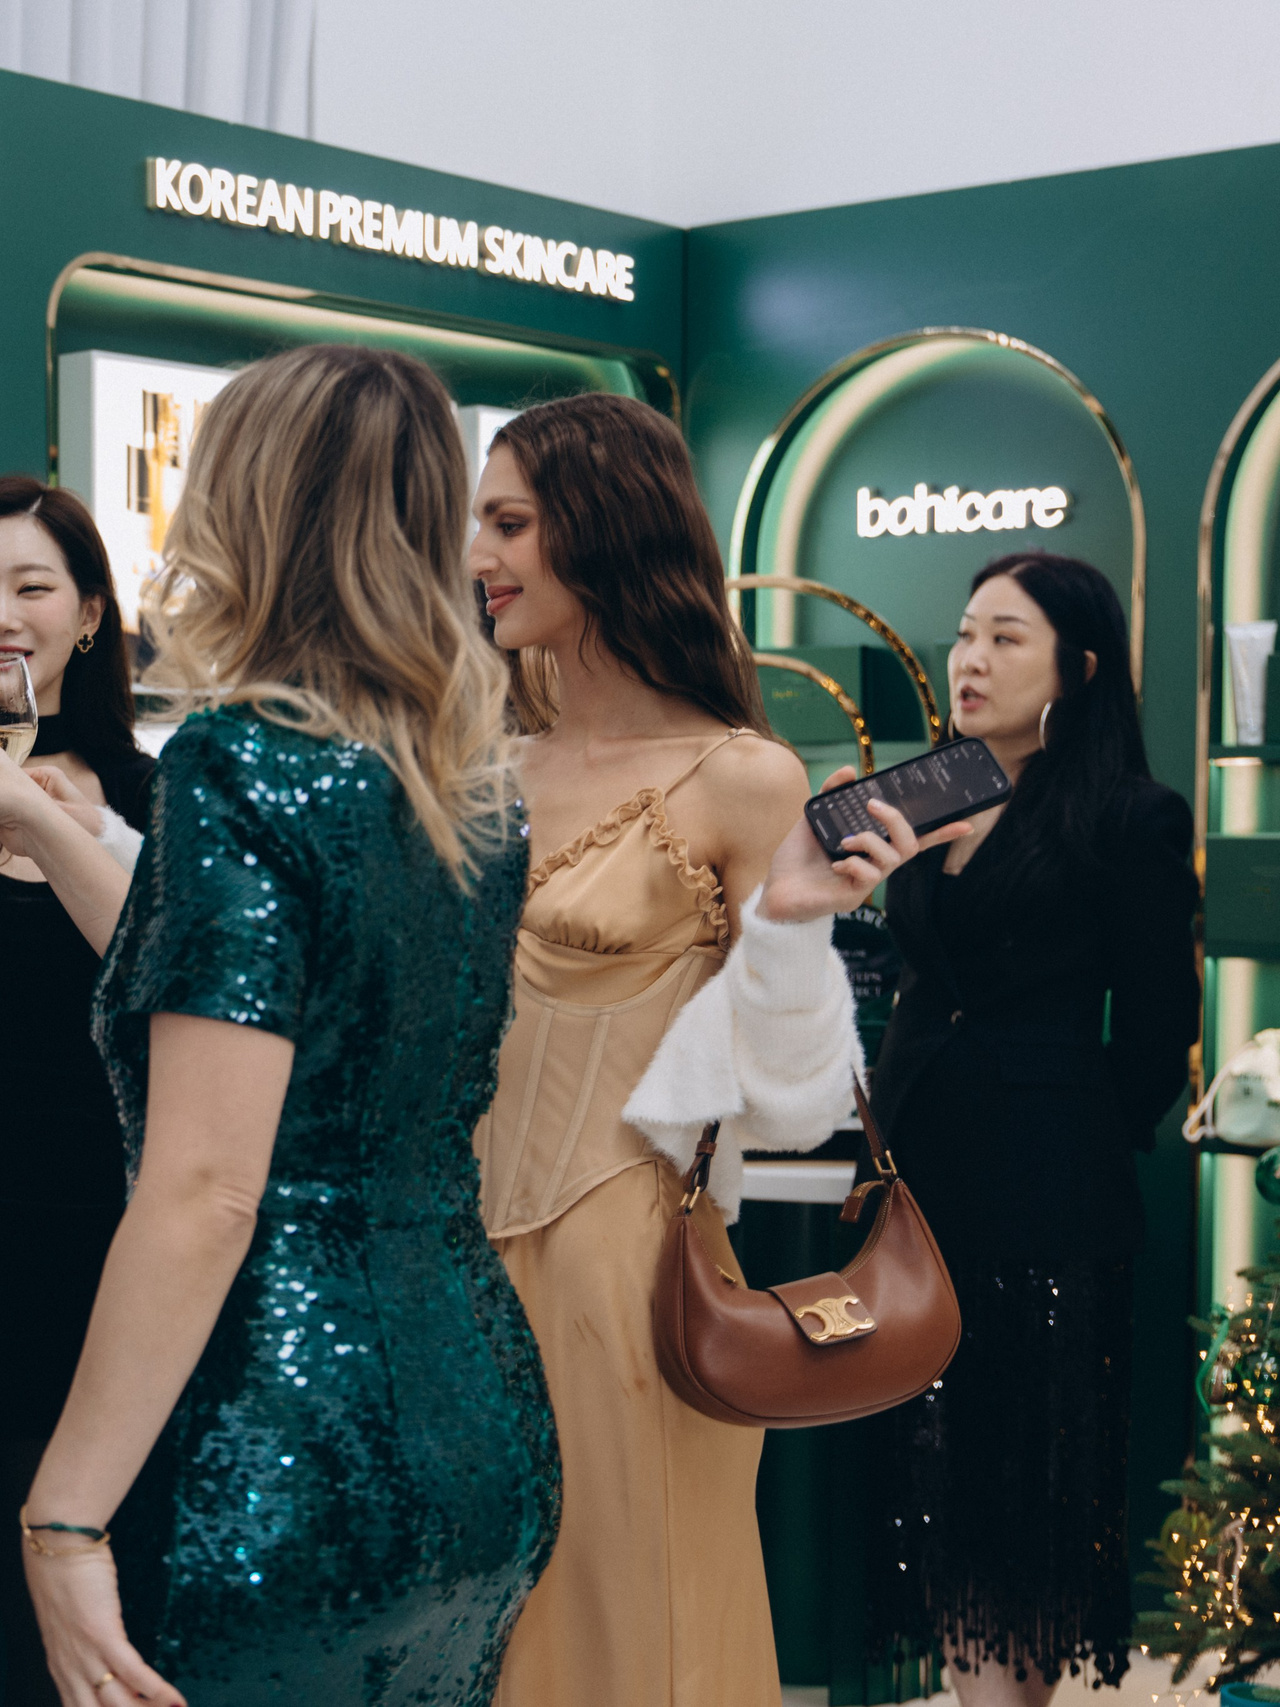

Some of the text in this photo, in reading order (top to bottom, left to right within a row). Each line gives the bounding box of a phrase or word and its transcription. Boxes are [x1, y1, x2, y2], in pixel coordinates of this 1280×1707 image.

[153, 157, 635, 302] KOREAN PREMIUM SKINCARE
[856, 482, 1068, 538] bohicare
